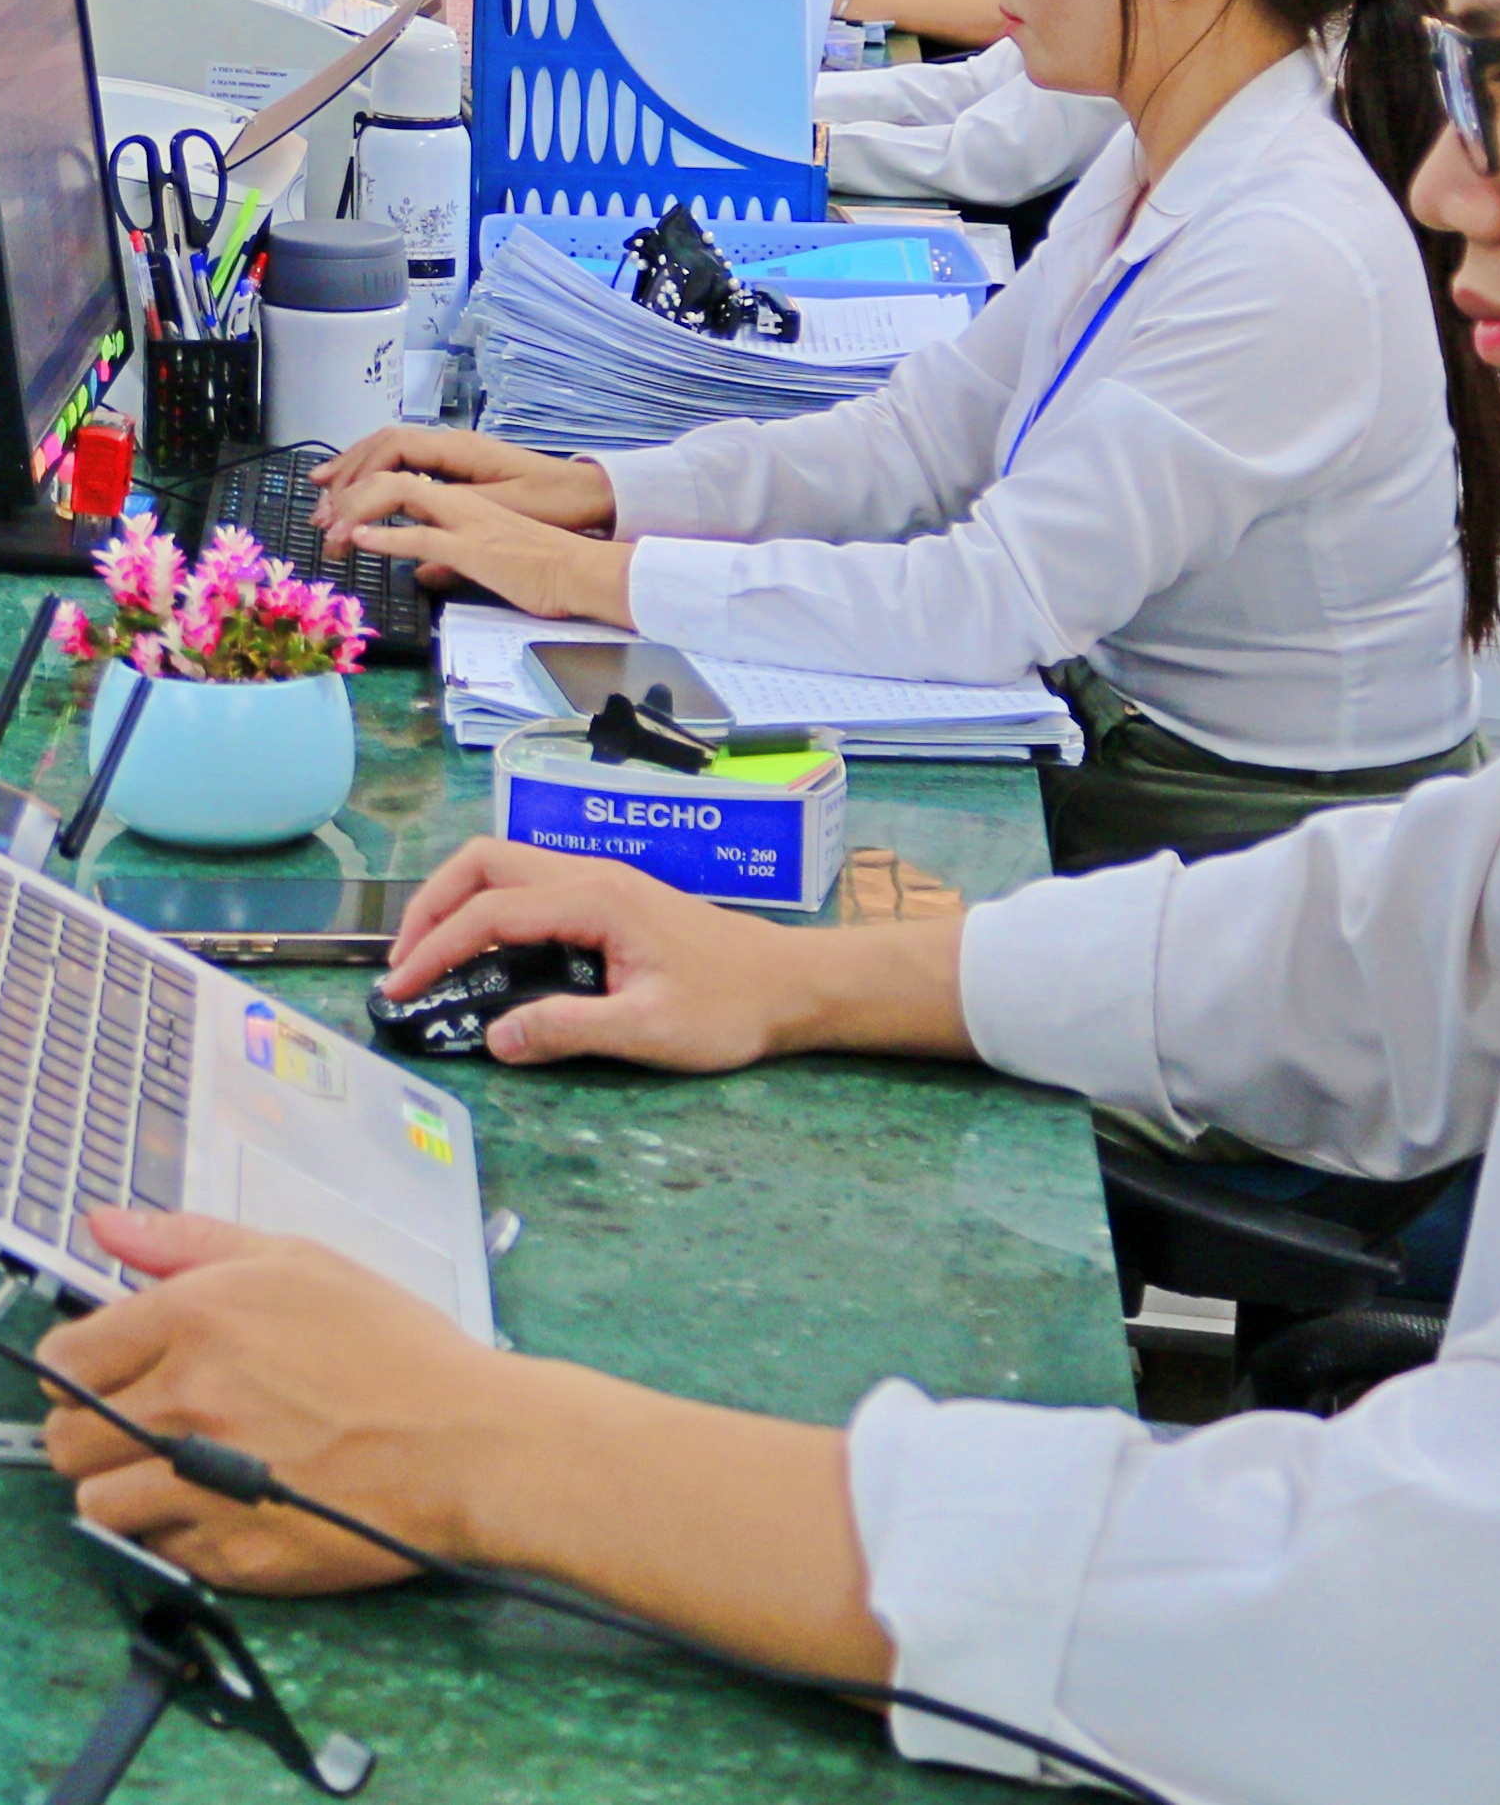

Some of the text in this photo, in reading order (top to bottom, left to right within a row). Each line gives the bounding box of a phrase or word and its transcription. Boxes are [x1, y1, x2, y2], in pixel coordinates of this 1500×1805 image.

[584, 796, 722, 831] SLECHO
[532, 829, 647, 856] DOUBLE CLIP
[716, 846, 778, 864] NO: 260
[738, 864, 776, 877] 1 DOZ
